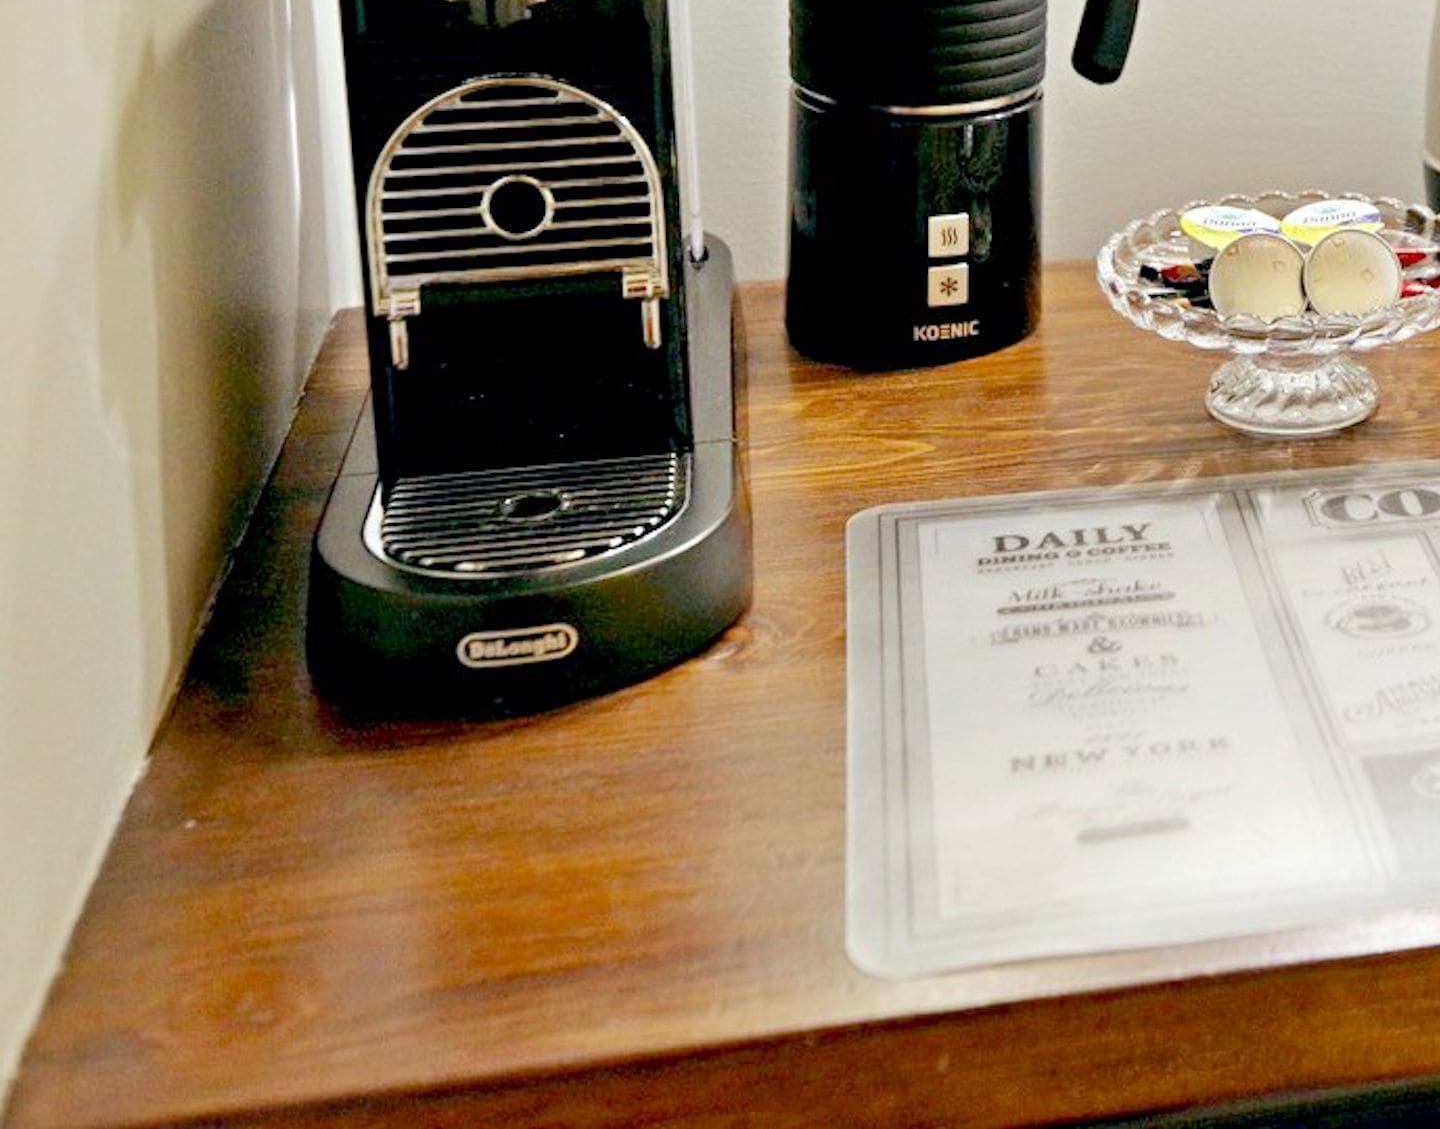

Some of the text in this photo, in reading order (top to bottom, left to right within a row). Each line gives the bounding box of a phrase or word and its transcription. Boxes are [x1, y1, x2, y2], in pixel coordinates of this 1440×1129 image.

[912, 319, 981, 342] KOENIC
[993, 522, 1152, 554] DAILY
[976, 551, 1059, 568] DINING
[1086, 541, 1172, 557] COFFEE
[1087, 635, 1122, 655] &
[1034, 655, 1180, 678] CAKES
[1010, 746, 1108, 773] NEW
[1123, 736, 1232, 762] YORK
